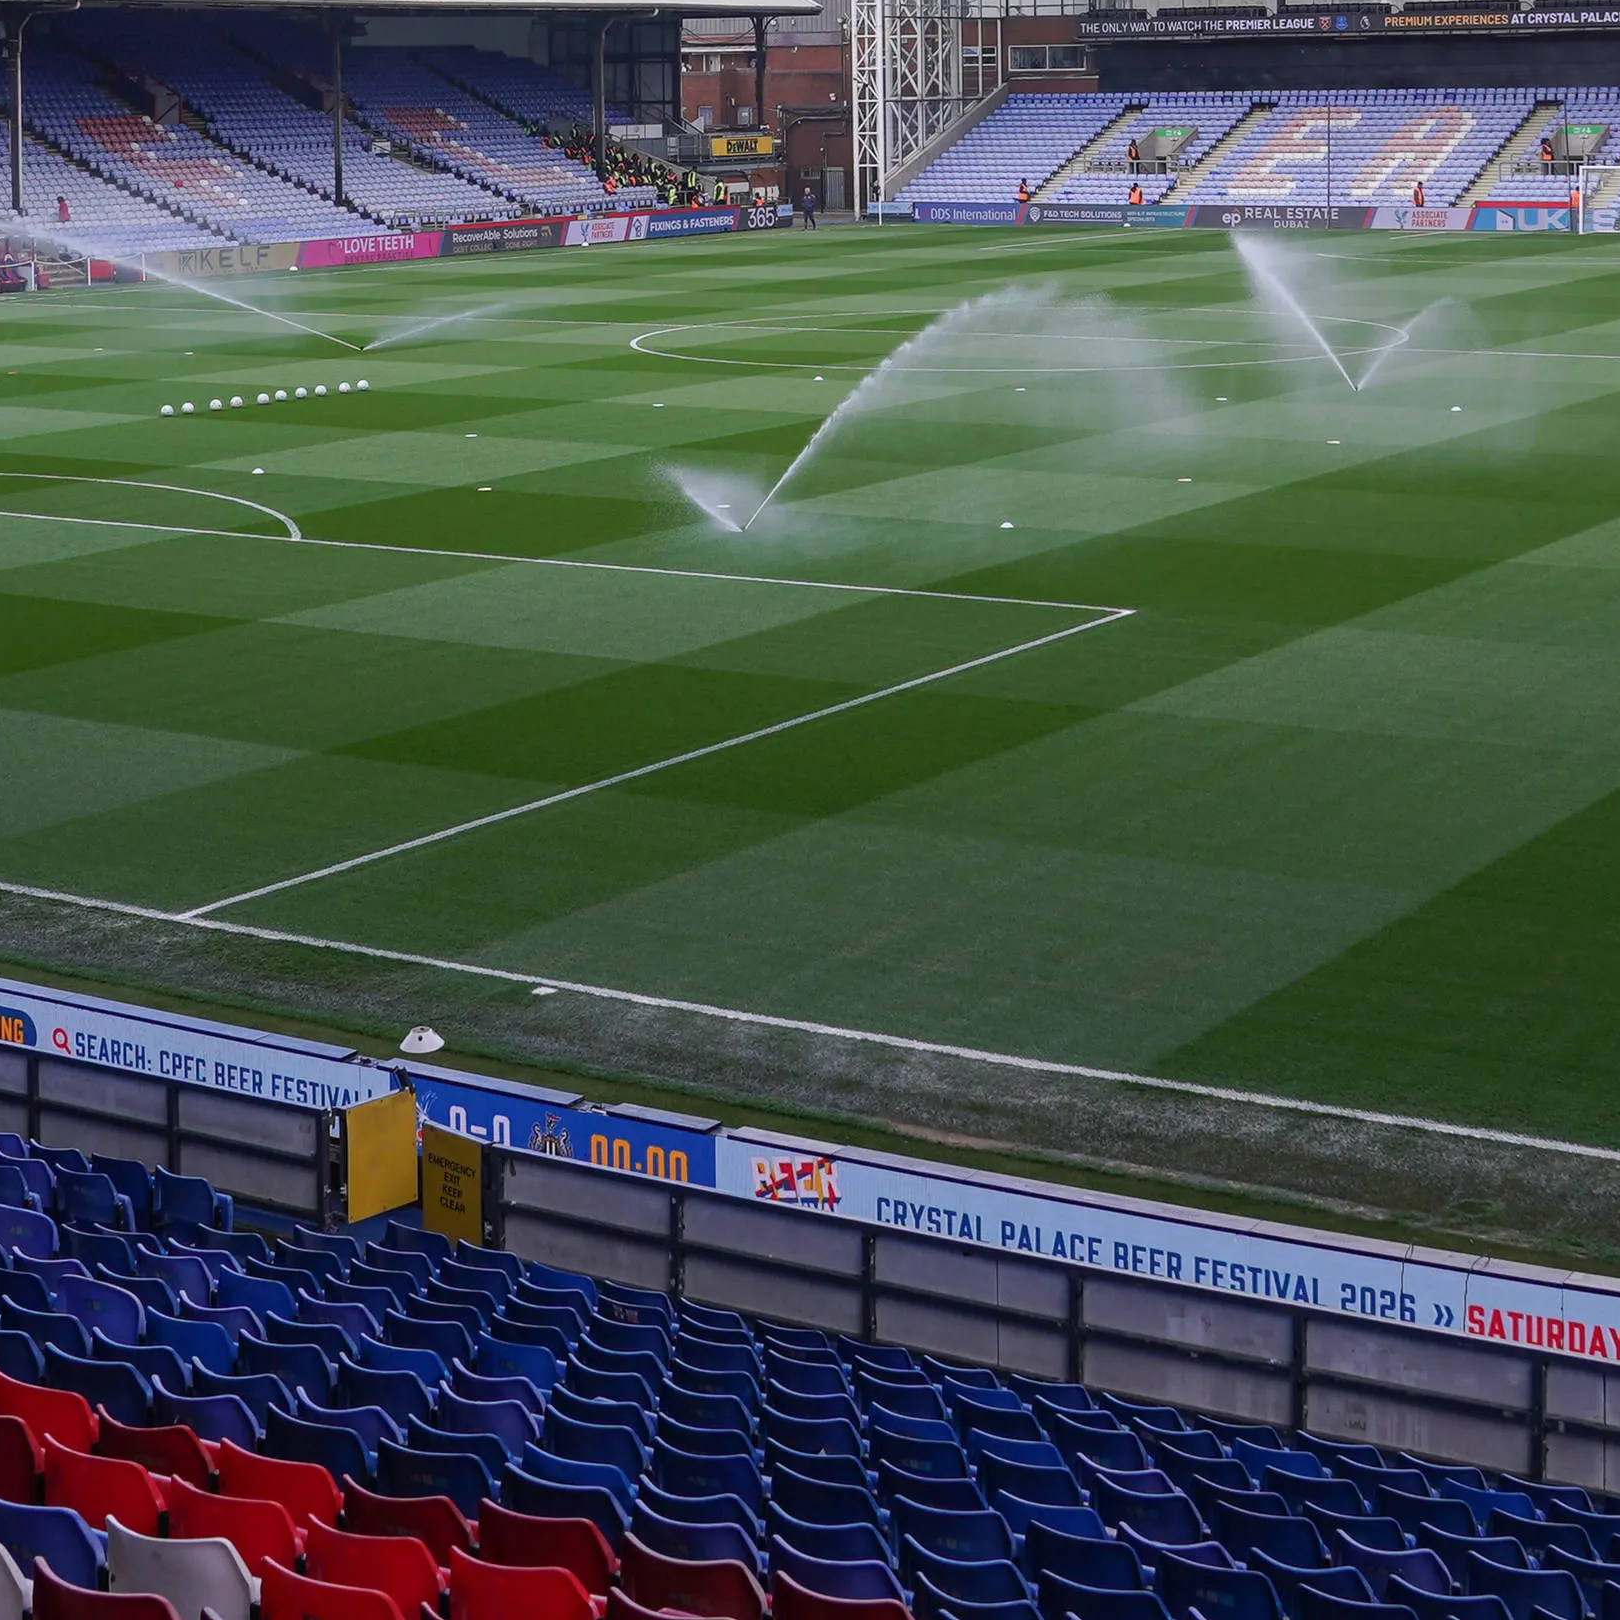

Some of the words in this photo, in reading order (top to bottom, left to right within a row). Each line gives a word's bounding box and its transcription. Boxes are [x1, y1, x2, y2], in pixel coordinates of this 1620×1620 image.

[953, 208, 1016, 220] International
[1081, 211, 1122, 219] SOLUTIONS
[1245, 208, 1283, 221] REAL
[1287, 208, 1339, 220] ESTATE
[1411, 211, 1448, 219] ASSOCIATE
[650, 220, 681, 231] FIXINGS
[683, 220, 689, 228] &
[690, 216, 733, 228] FASTENERS
[1274, 220, 1309, 228] DUBAI
[1411, 219, 1446, 228] PARTNERS
[453, 230, 500, 243] RecoverAble
[503, 227, 538, 239] Solutions
[344, 238, 375, 253] LOVE
[377, 235, 414, 251] TEETH
[200, 245, 270, 271] KELF
[75, 1032, 152, 1073] SEARCH:
[160, 1049, 206, 1082] CPFC
[215, 1062, 263, 1094] BEER
[427, 1153, 477, 1179] EMERGENCY
[443, 1172, 461, 1187] EXIT
[442, 1183, 463, 1199] KEEP
[439, 1195, 466, 1215] CLEAR
[876, 1197, 990, 1246] CRYSTAL
[1000, 1220, 1102, 1266] PALACE
[1113, 1241, 1182, 1280] BEER
[1194, 1256, 1327, 1307] FESTIVAL
[1340, 1282, 1416, 1324] 2026
